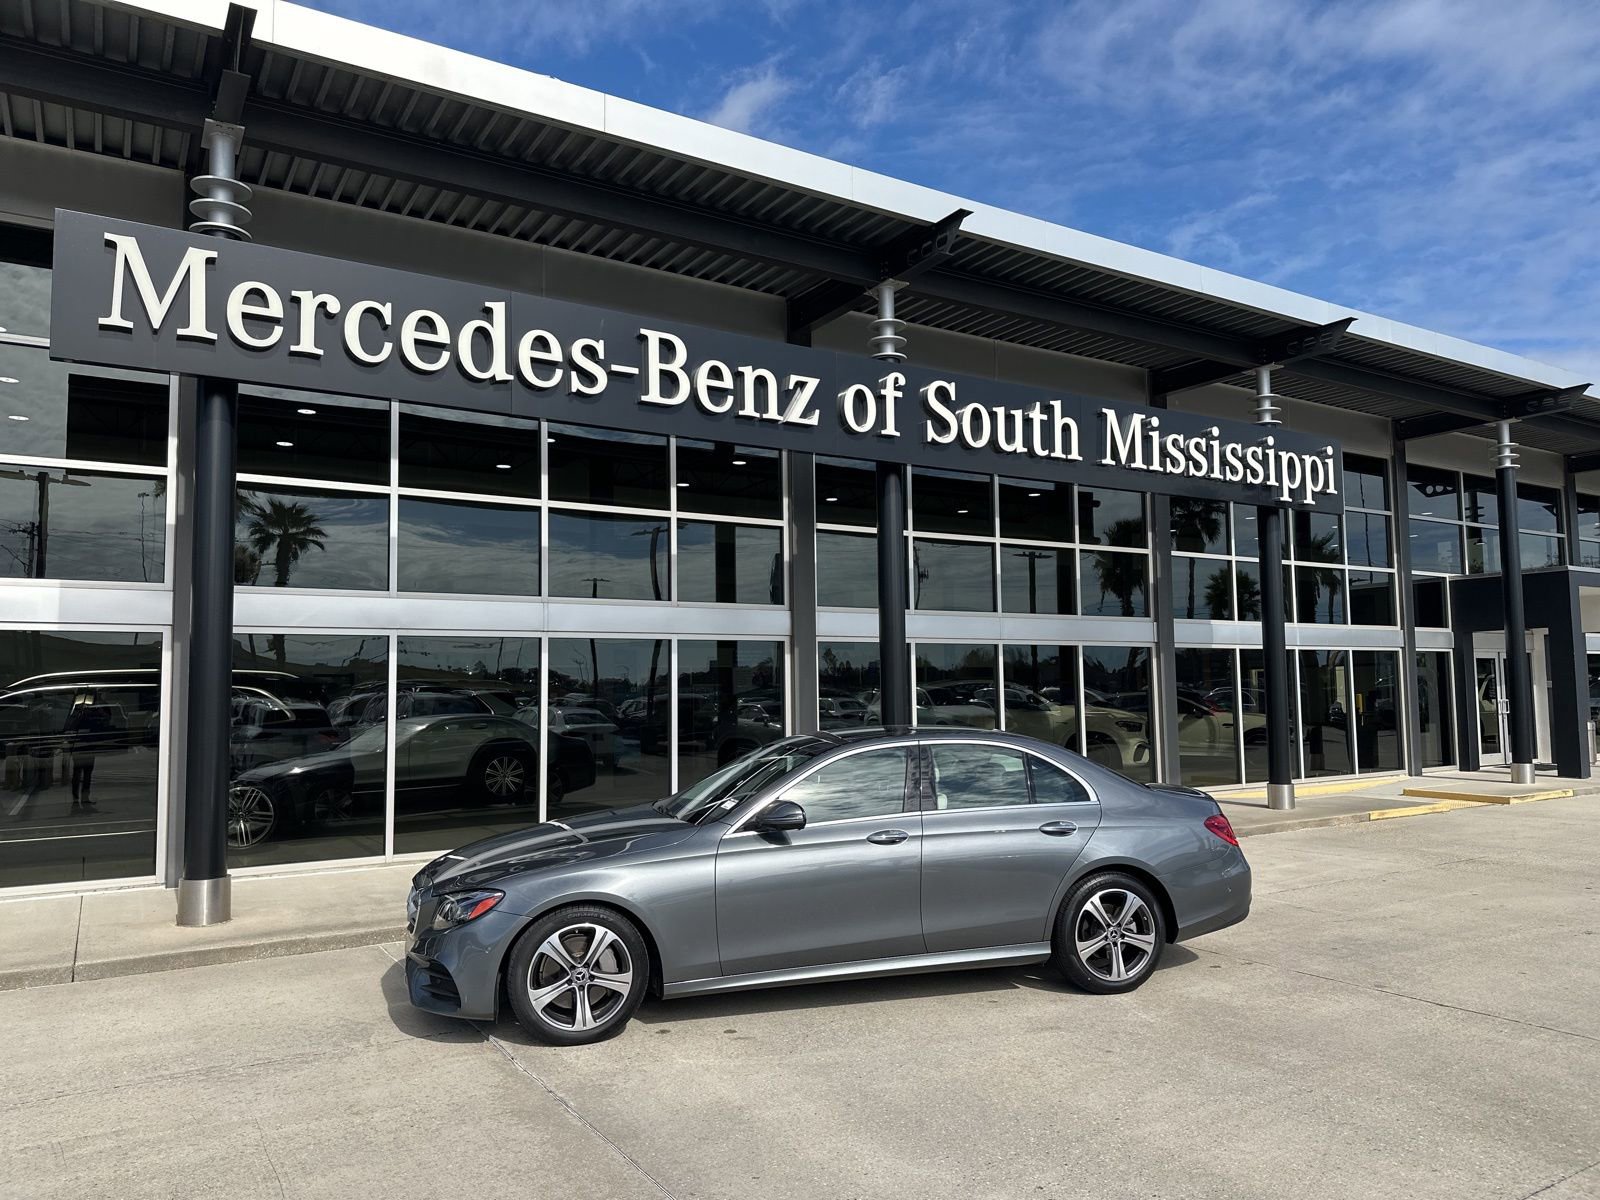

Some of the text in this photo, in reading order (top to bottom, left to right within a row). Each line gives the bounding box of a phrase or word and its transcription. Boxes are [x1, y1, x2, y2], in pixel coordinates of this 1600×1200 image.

[98, 231, 1338, 505] Mercedes-Benz of South Mississippi
